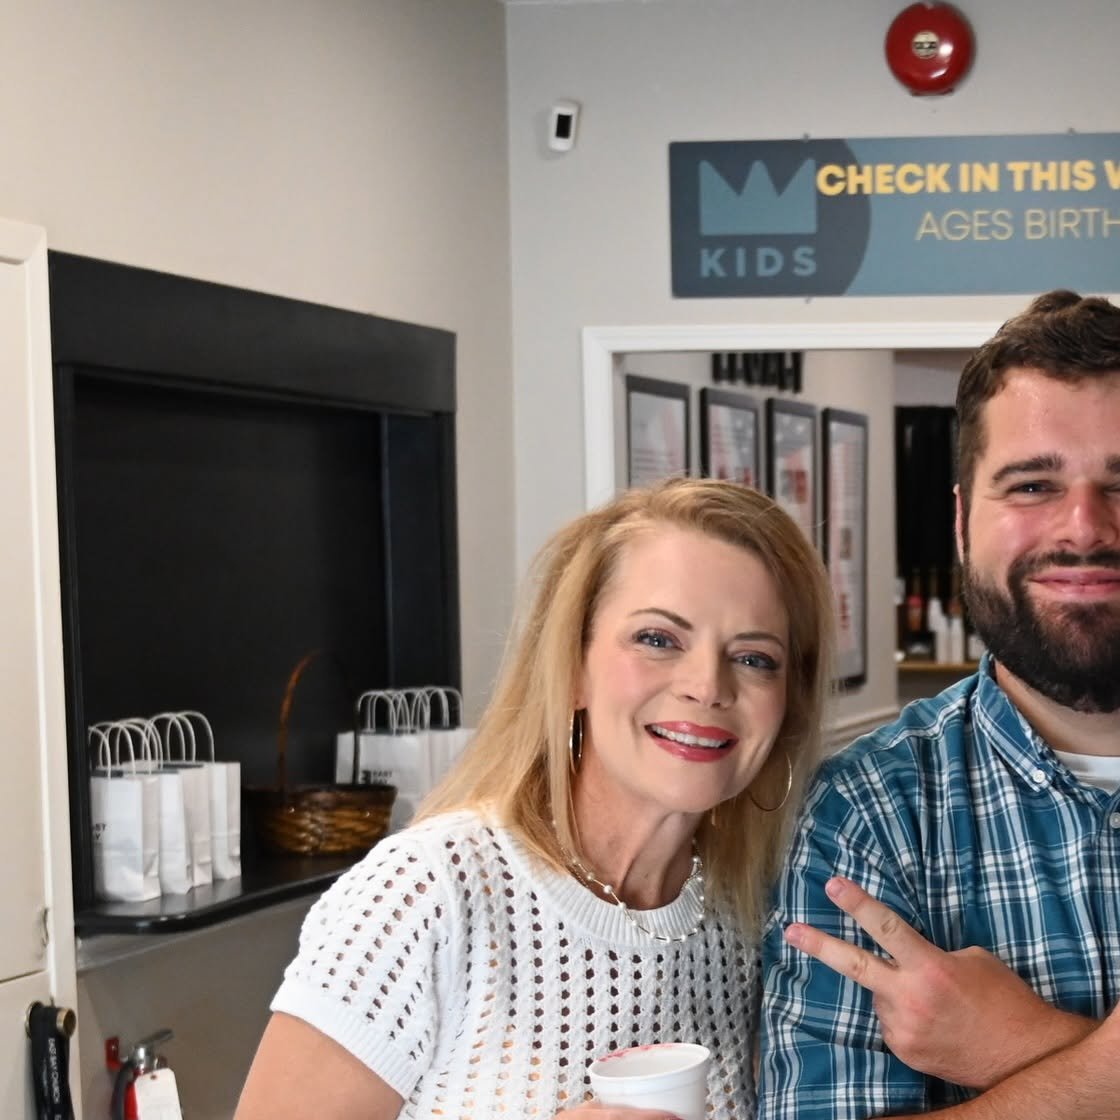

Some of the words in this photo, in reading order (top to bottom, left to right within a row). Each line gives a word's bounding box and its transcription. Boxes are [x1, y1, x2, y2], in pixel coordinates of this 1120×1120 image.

[816, 163, 951, 196] CHECK
[959, 162, 1000, 193] IN
[1006, 160, 1096, 192] THIS
[915, 209, 1014, 241] AGES
[701, 247, 817, 278] KIDS
